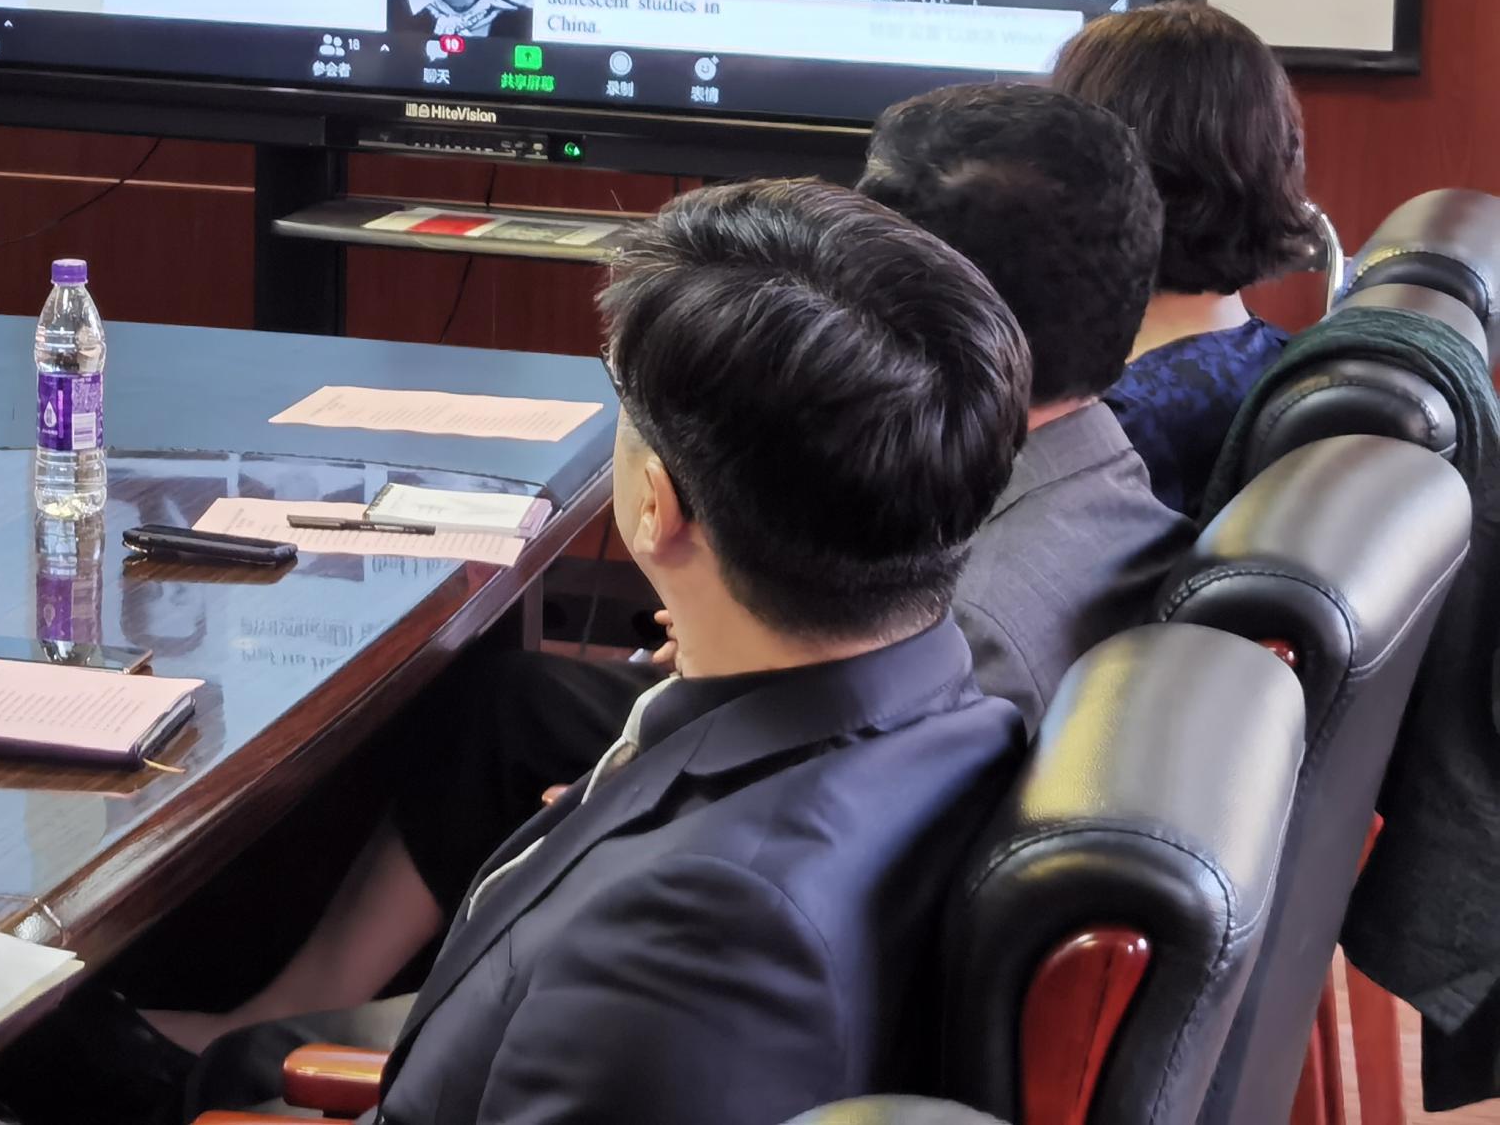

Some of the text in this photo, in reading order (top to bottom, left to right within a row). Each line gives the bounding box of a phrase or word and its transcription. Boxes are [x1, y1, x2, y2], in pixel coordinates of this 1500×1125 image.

[547, 14, 601, 33] China.
[312, 60, 351, 78] 参会者
[501, 73, 555, 92] 共享屏幕
[431, 104, 497, 124] HiteVision
